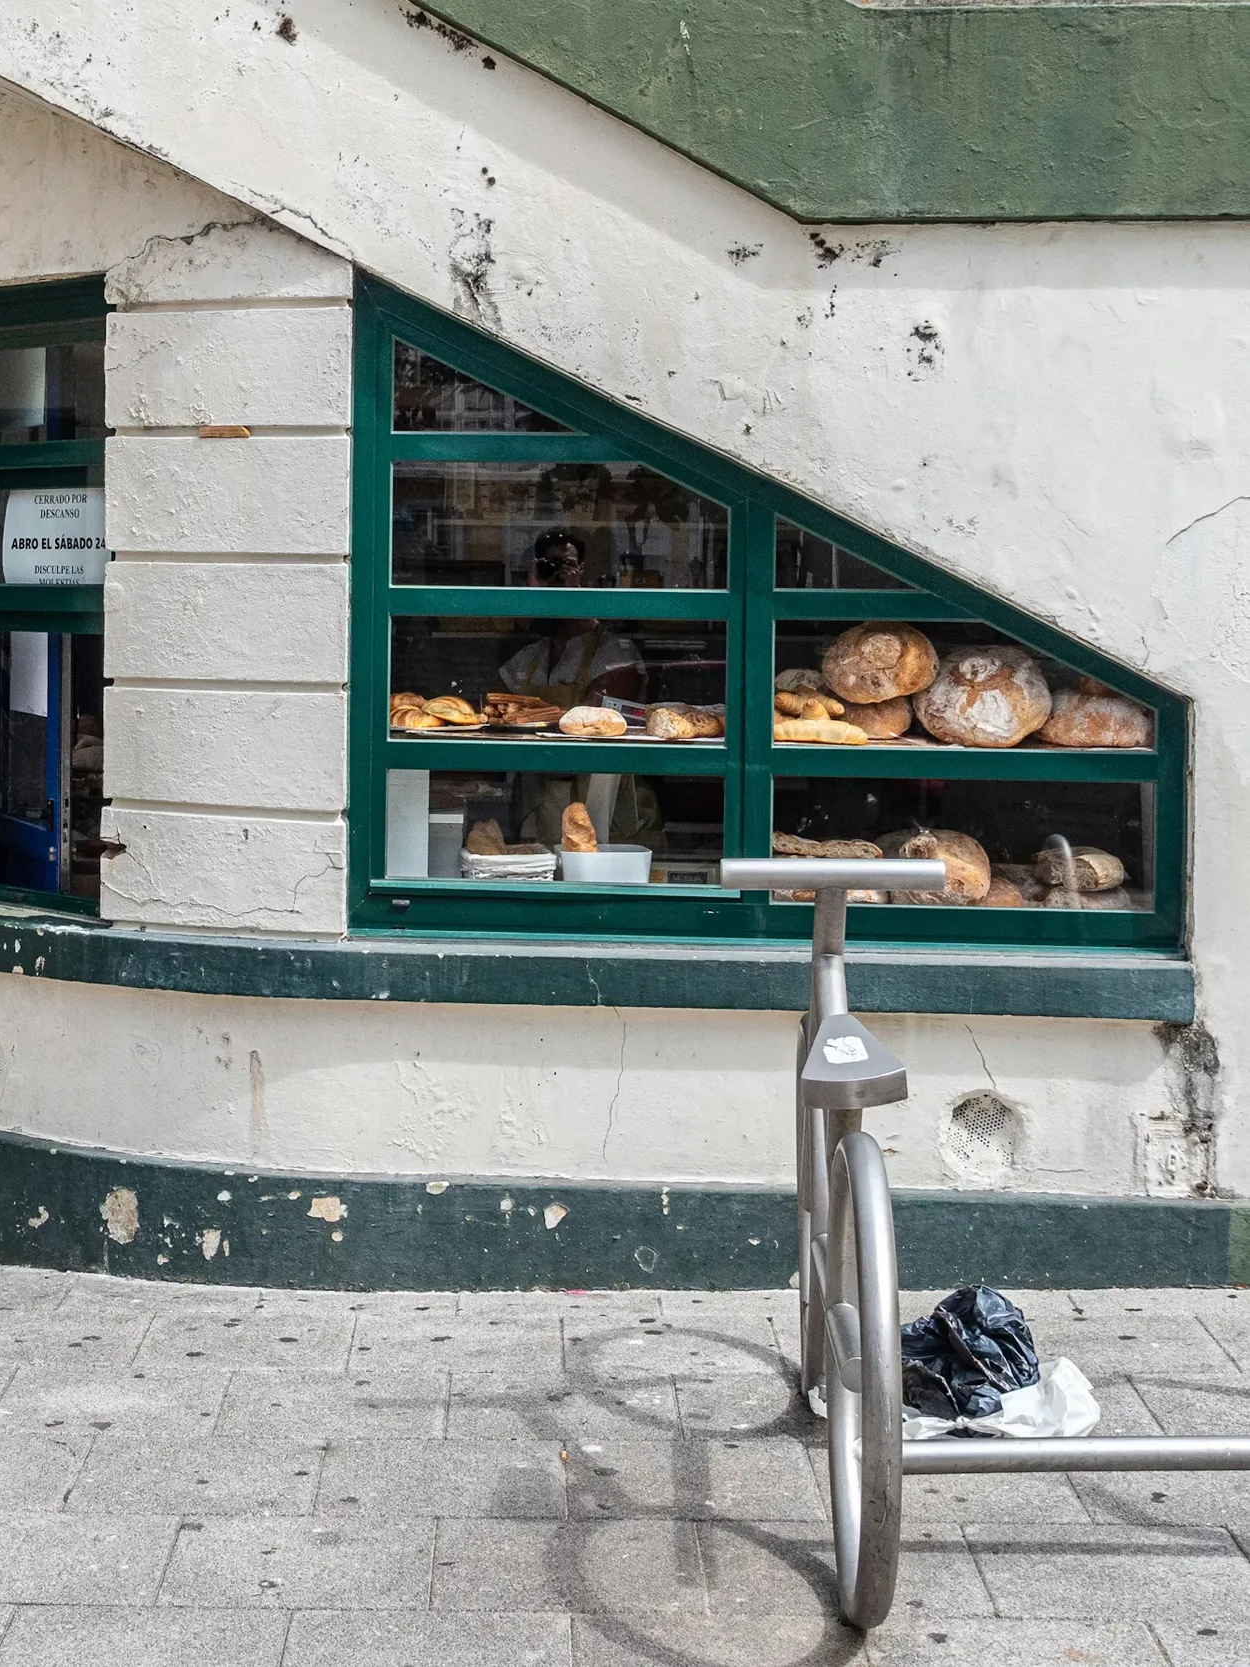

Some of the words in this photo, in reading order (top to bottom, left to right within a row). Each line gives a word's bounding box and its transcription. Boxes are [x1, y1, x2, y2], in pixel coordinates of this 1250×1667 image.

[34, 494, 70, 504] CERRADO
[71, 494, 87, 503] POR
[40, 508, 80, 519] DESCANSO
[11, 537, 39, 550] ABRO
[41, 537, 52, 550] EL
[54, 534, 93, 550] SÁBADO
[34, 565, 70, 574] DISCULPE
[71, 565, 84, 574] LAS
